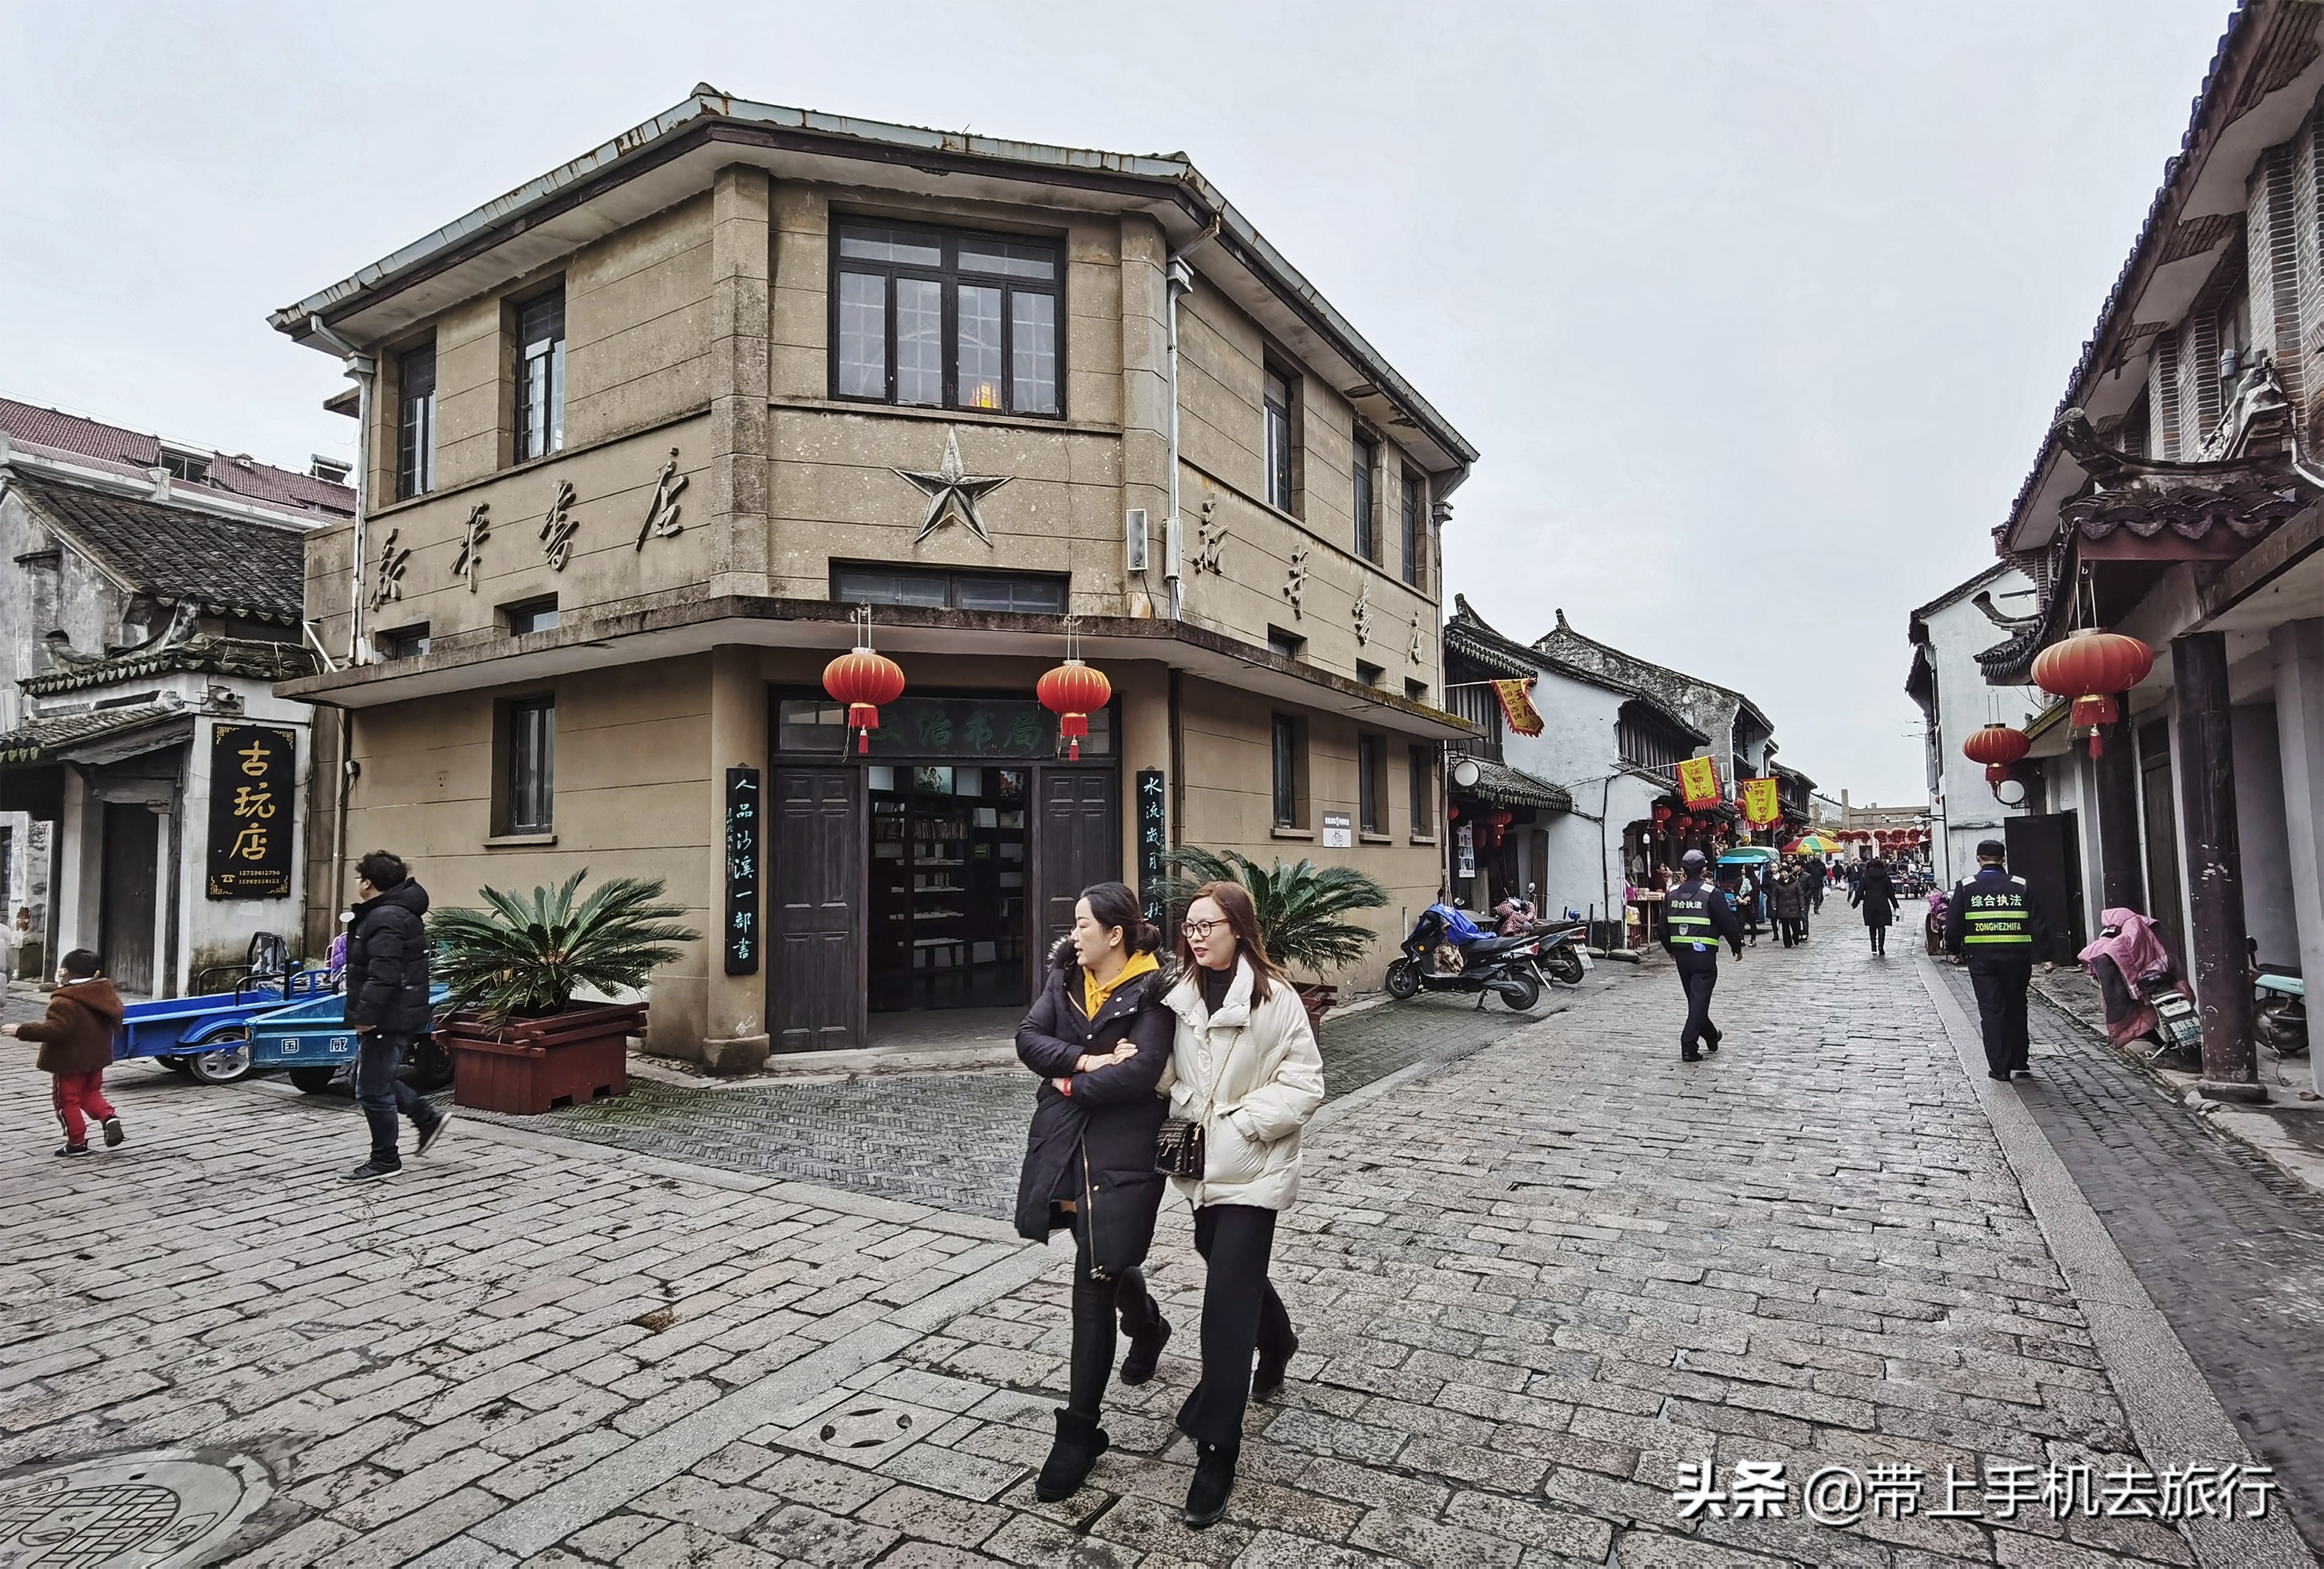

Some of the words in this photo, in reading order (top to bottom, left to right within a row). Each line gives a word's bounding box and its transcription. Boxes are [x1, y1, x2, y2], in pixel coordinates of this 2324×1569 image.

[229, 739, 276, 861] 古玩店
[1671, 900, 1703, 909] 综合执法
[1971, 894, 2022, 907] 综合执法
[1975, 922, 2022, 932] ZONGHEZHIFA
